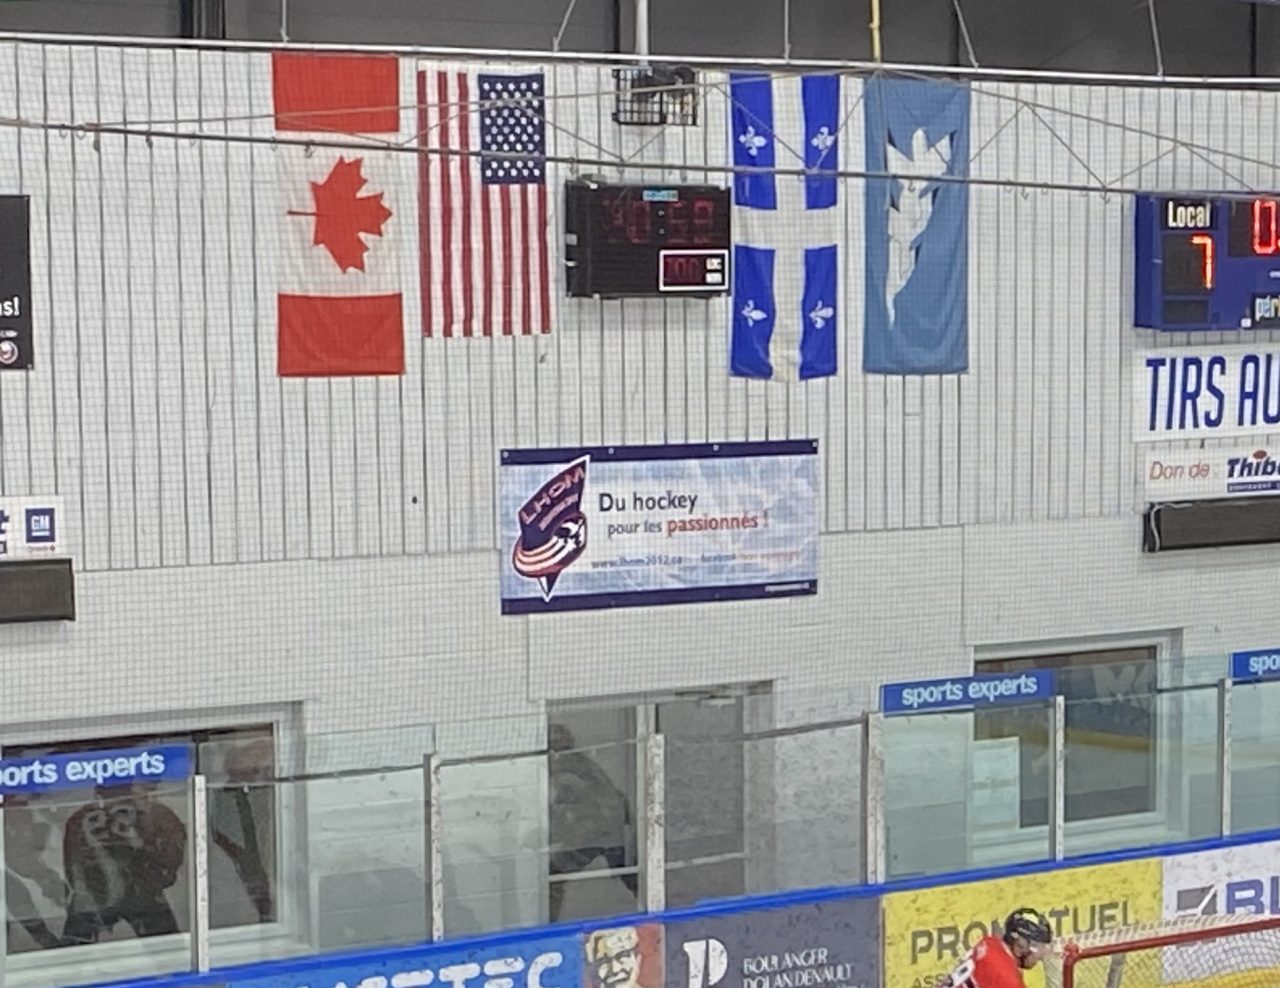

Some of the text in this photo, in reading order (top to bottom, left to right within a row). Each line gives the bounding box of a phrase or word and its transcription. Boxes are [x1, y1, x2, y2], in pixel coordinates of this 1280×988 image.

[1168, 200, 1211, 228] Local
[1191, 235, 1213, 289] 7
[1146, 355, 1227, 431] TIRS
[1150, 460, 1187, 480] Don
[1188, 460, 1210, 477] de
[599, 490, 698, 514] Du hockey
[607, 522, 639, 538] pour
[644, 520, 663, 534] les
[667, 512, 758, 538] passionnés
[902, 674, 1038, 708] sports experts
[0, 751, 165, 786] orts experts
[911, 900, 1136, 965] PROTUEL
[744, 948, 828, 975] BOULANGER
